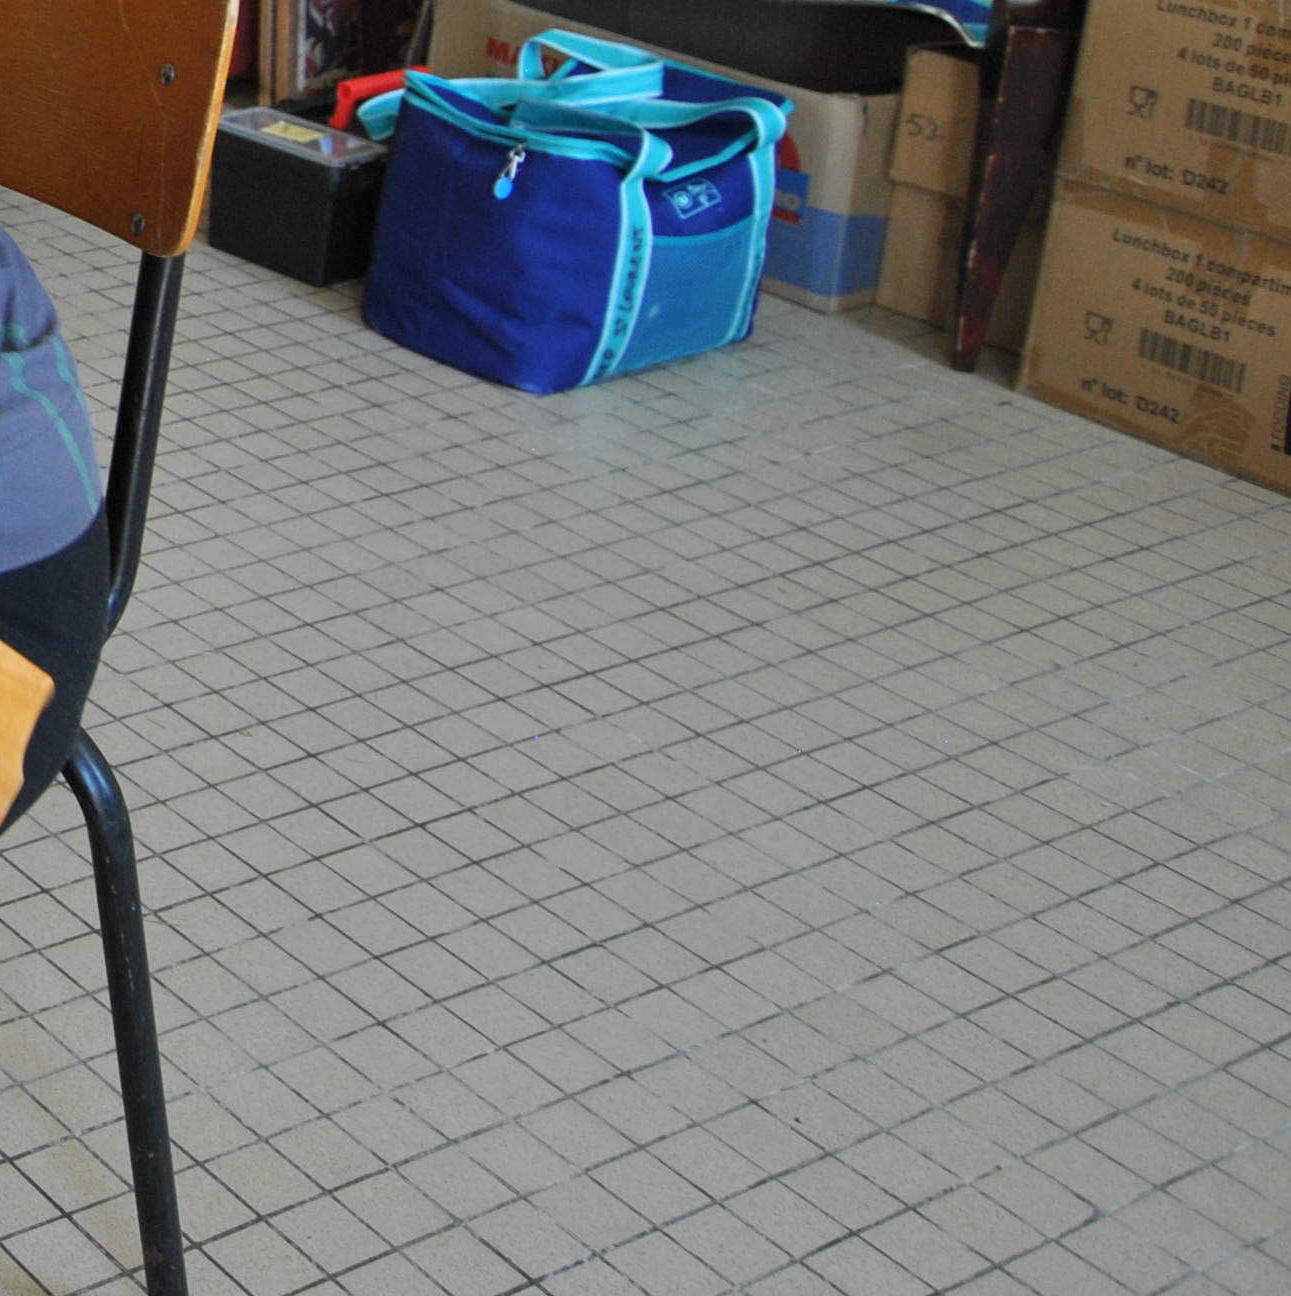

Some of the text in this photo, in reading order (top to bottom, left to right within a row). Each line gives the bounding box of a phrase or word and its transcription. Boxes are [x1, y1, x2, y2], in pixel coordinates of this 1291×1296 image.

[1243, 15, 1253, 31] 1
[1212, 32, 1244, 53] 200
[1176, 46, 1188, 62] 4
[1190, 48, 1221, 71] lots
[1225, 57, 1247, 76] de
[1249, 63, 1271, 82] 50
[1212, 76, 1284, 108] BAGLB1
[1182, 169, 1230, 196] D242
[1112, 227, 1191, 265] Lunchbox
[1195, 253, 1204, 268] 1
[1165, 266, 1195, 289] 200
[1132, 276, 1142, 291] 4
[1144, 281, 1174, 304] lots
[1177, 290, 1197, 309] de
[1198, 299, 1220, 319] 50
[1163, 309, 1232, 345] BAGLB1
[1135, 396, 1181, 424] D242
